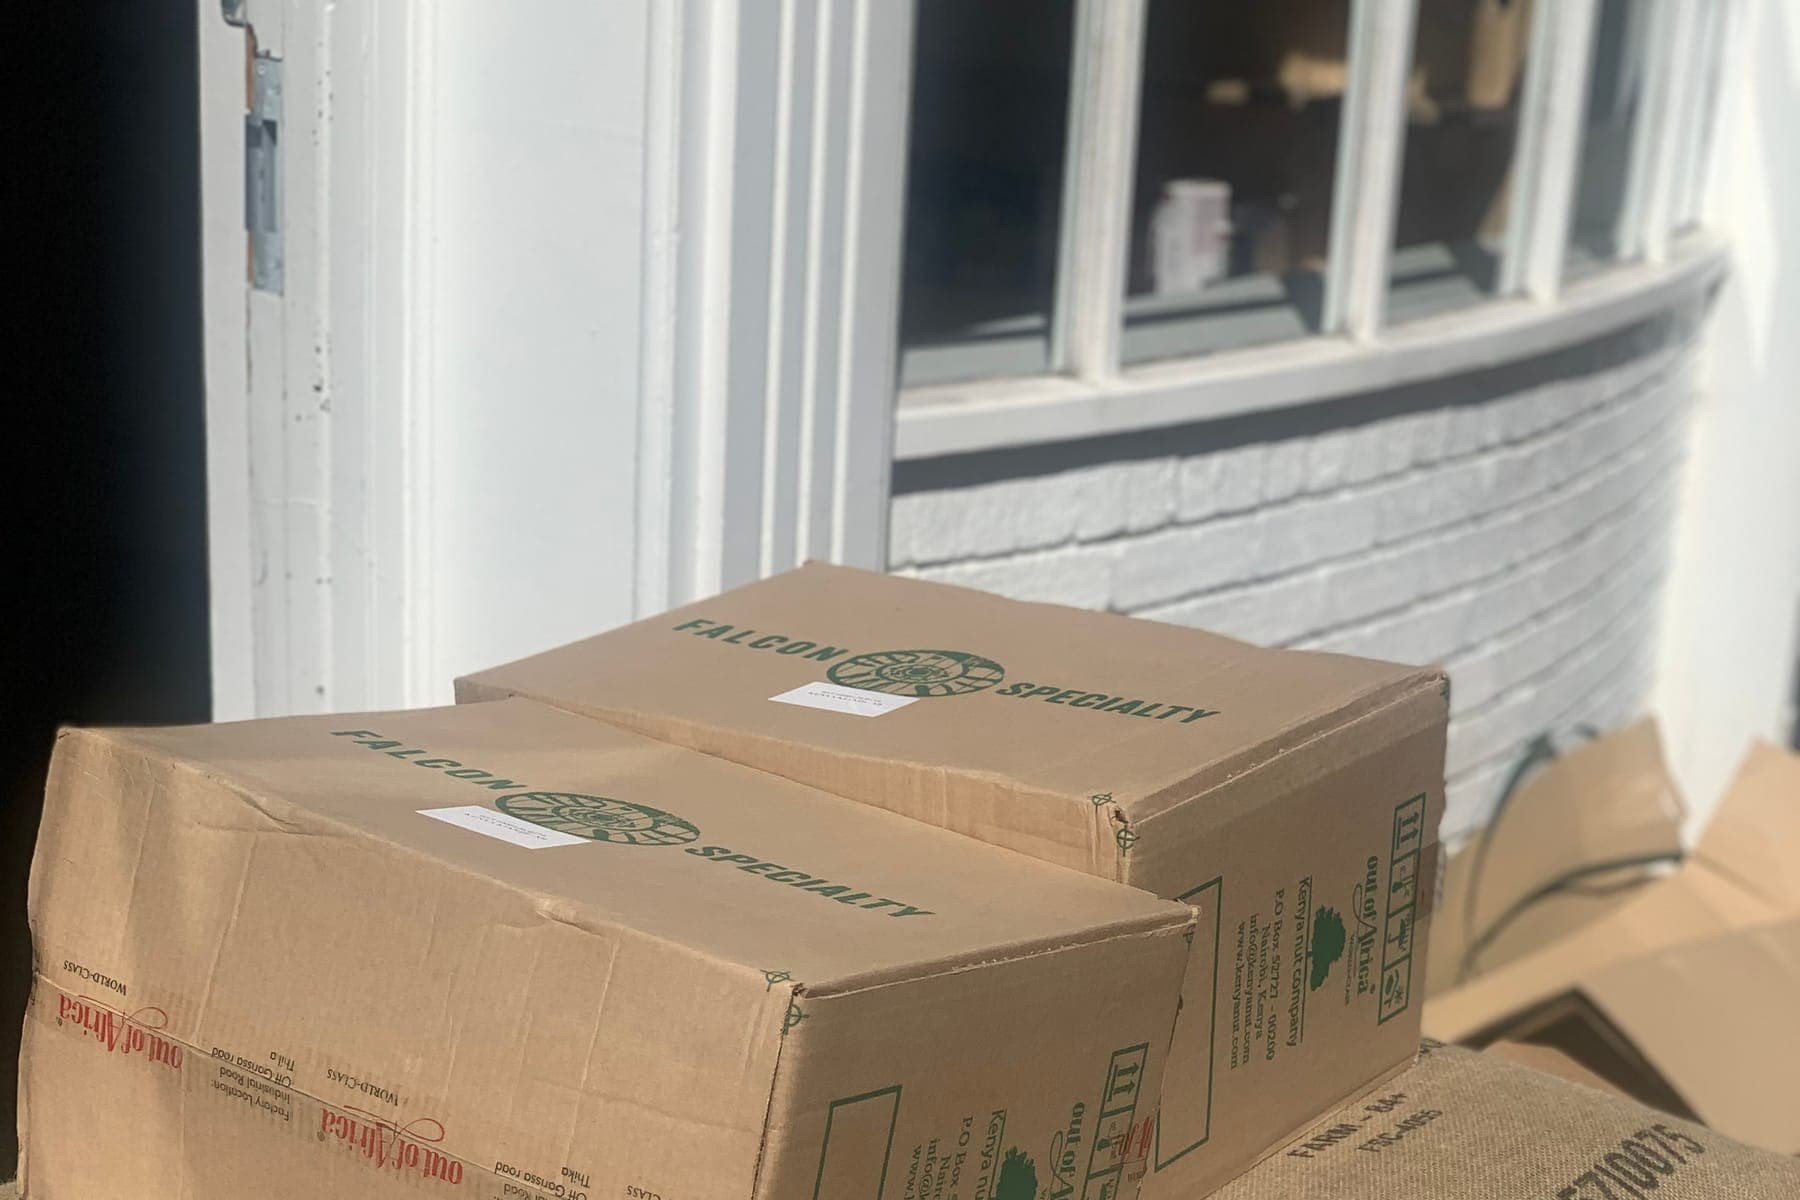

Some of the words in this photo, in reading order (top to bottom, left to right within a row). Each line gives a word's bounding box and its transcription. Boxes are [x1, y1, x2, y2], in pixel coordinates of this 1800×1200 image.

[672, 618, 848, 662] FALCON
[993, 682, 1221, 724] SPECIALTY
[331, 728, 527, 791] FALCON
[683, 845, 936, 919] SPECIALTY
[1366, 855, 1379, 899] out
[1295, 877, 1311, 929] Kenya
[1362, 899, 1376, 929] of
[1272, 918, 1285, 947] Box
[1294, 930, 1304, 965] nut
[62, 959, 128, 997] WORLD-CLASS
[1230, 920, 1248, 1071] www.kenyanut.com
[1241, 912, 1262, 1066] info@kenyanut.com
[1255, 988, 1268, 1041] Kenya
[1286, 966, 1302, 1048] company
[120, 1023, 146, 1055] of
[149, 1038, 184, 1073] out
[210, 1047, 235, 1064] road
[218, 1066, 245, 1086] Road
[235, 1056, 273, 1082] Garissa
[271, 1071, 291, 1089] Off
[210, 1079, 253, 1107] Location:
[325, 1067, 400, 1107] WORLD-CLASS
[254, 1093, 290, 1122] Factory
[1064, 1101, 1086, 1146] out
[391, 1137, 420, 1170] of
[979, 1109, 1007, 1171] Kenya
[1287, 1122, 1364, 1159] FARM
[422, 1148, 463, 1185] out
[493, 1160, 522, 1180] road
[560, 1165, 591, 1189] Thika
[950, 1150, 968, 1187] Box
[1058, 1147, 1078, 1182] of
[523, 1171, 566, 1199] Garissa
